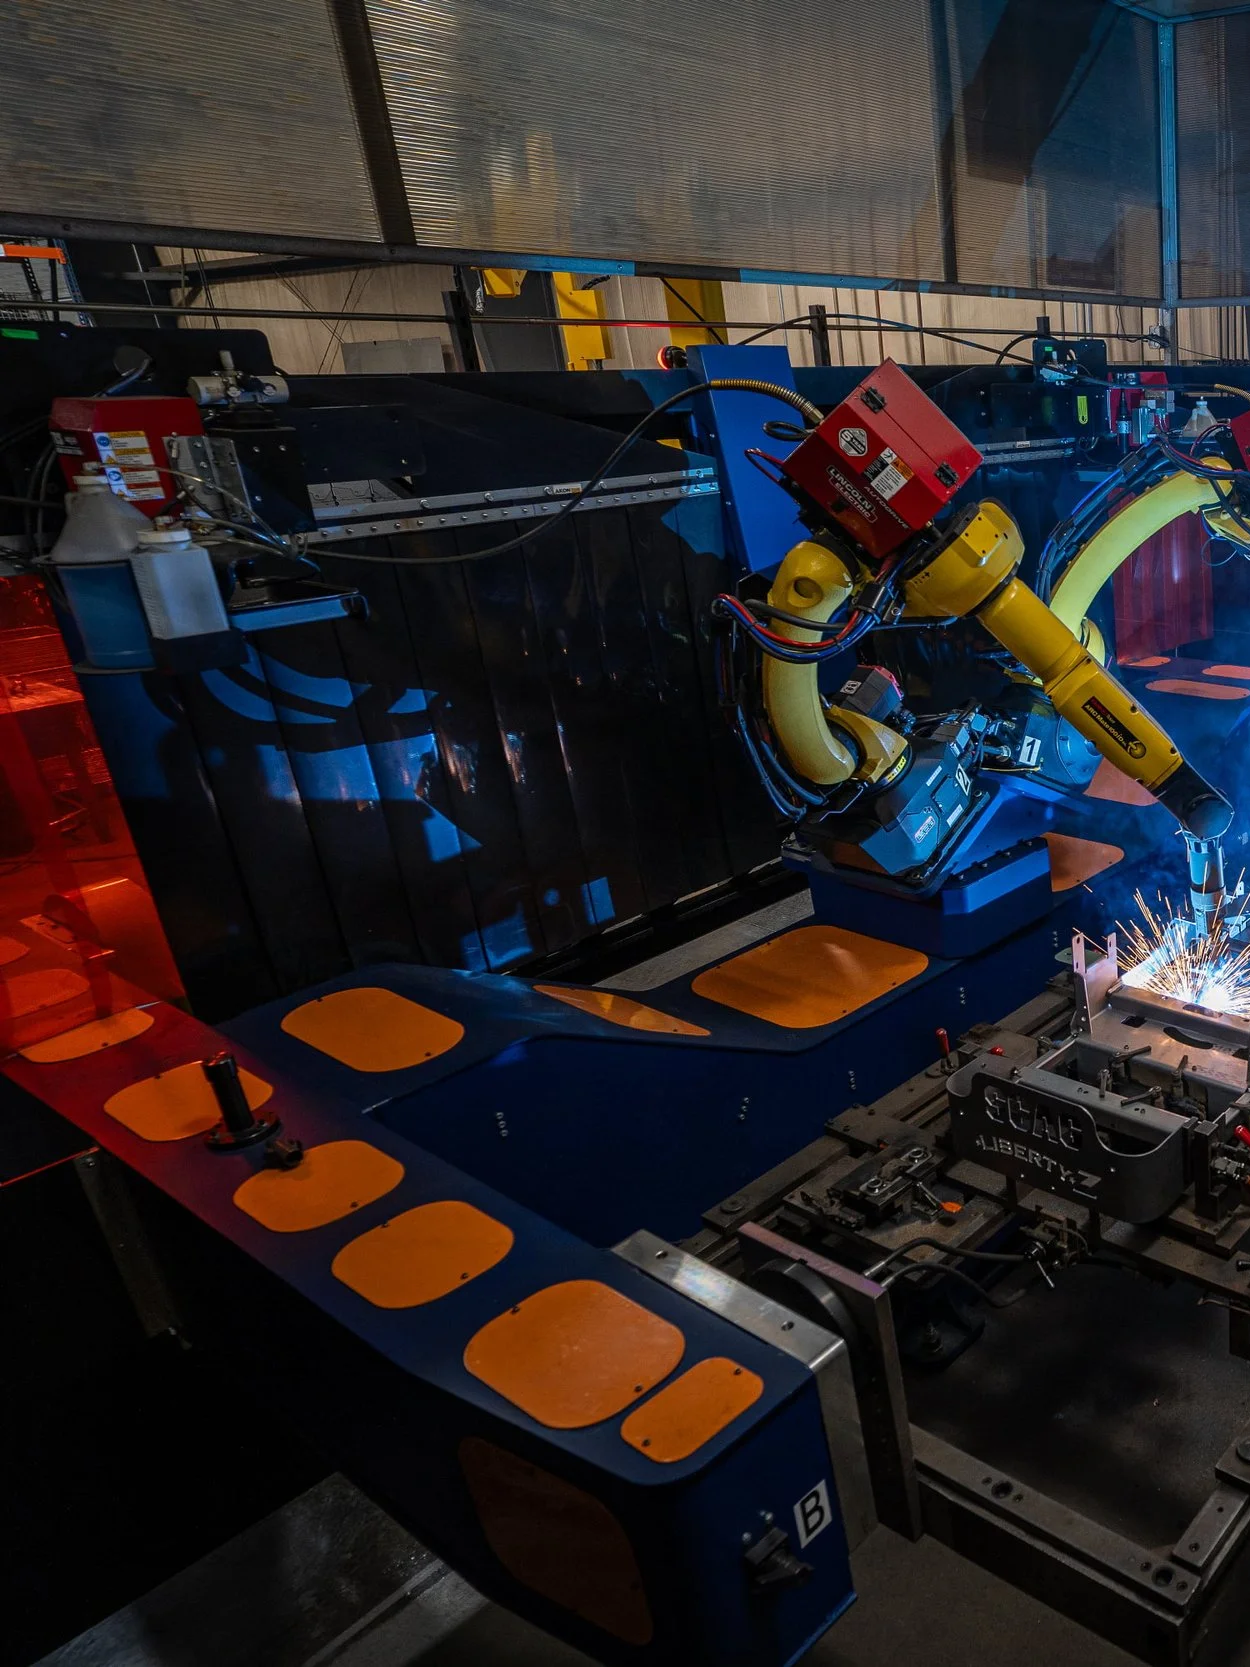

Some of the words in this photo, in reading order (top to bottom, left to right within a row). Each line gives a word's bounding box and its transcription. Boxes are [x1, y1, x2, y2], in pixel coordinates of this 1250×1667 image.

[829, 467, 872, 511] LINCOLN
[835, 482, 872, 519] ELECTRIC
[863, 486, 910, 530] AUTODRIVE
[1026, 738, 1037, 763] 1
[956, 767, 971, 793] 2
[800, 1489, 825, 1539] B
